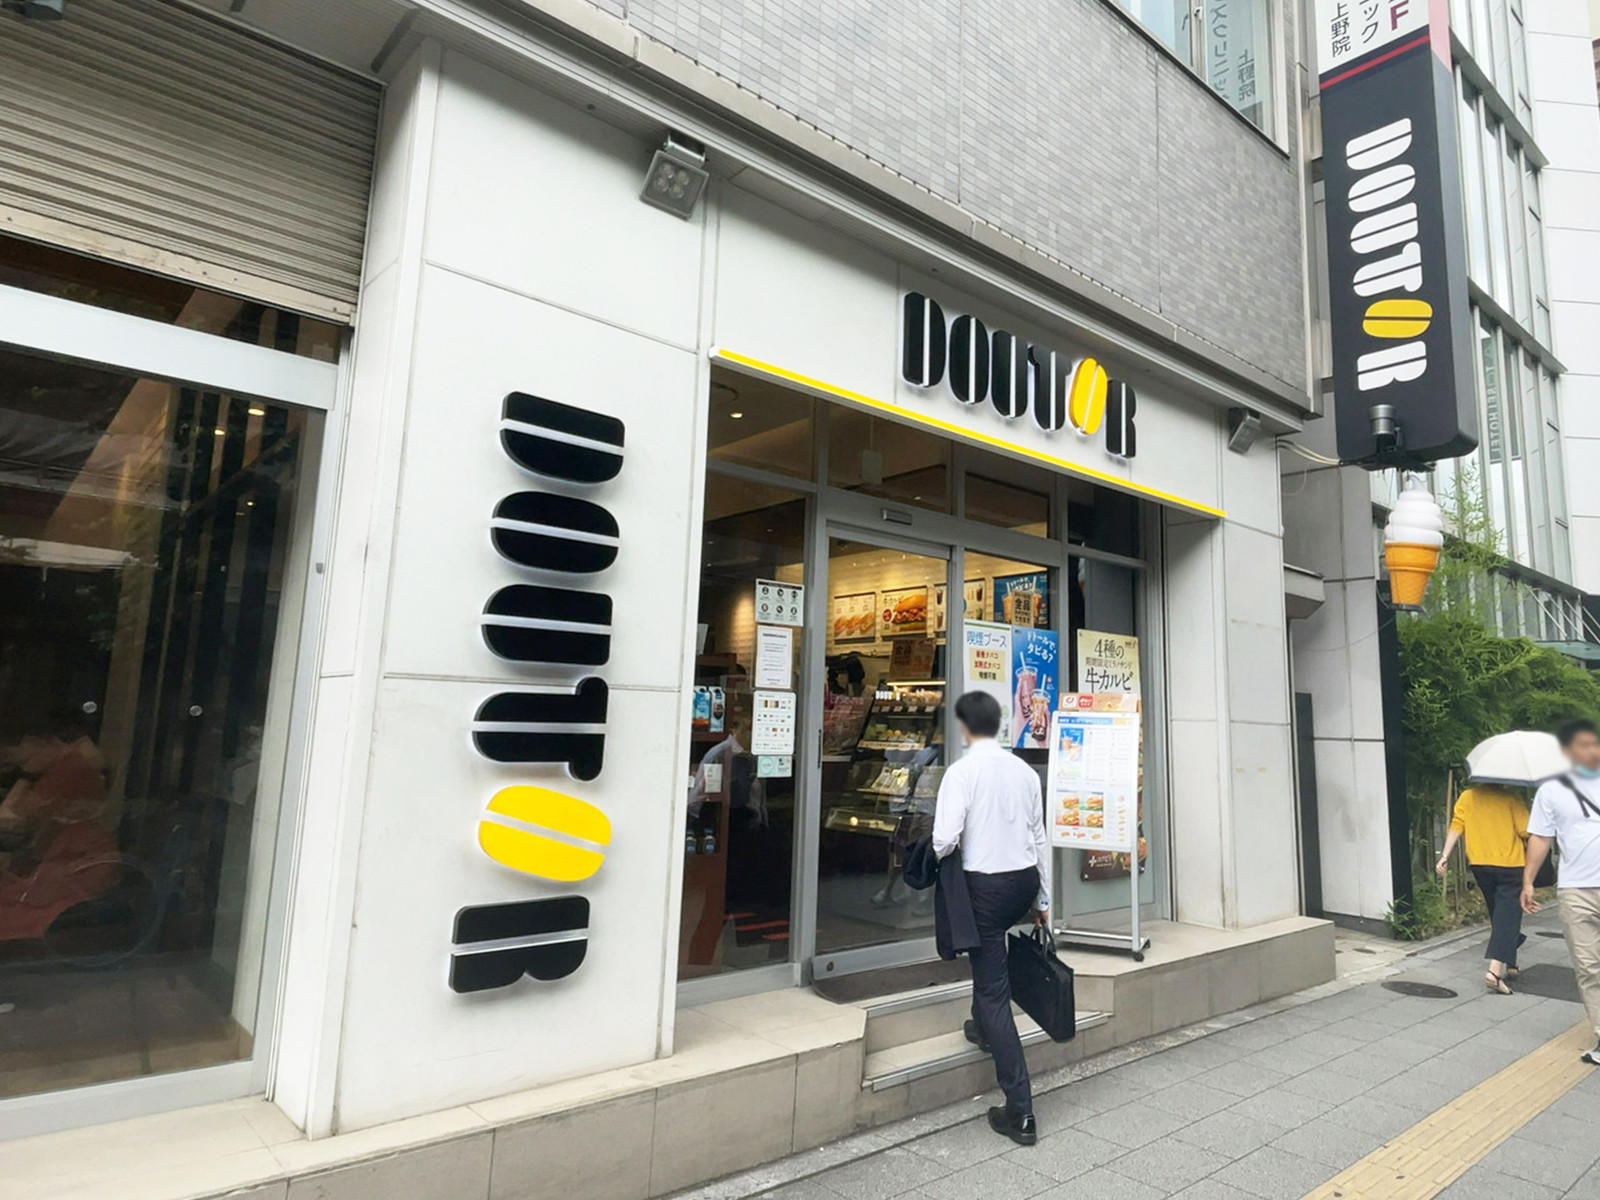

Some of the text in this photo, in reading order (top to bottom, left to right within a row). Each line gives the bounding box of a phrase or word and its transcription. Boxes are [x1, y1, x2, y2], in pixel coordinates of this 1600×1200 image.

[1330, 2, 1351, 58] 上野院
[1389, 0, 1409, 31] F
[1345, 117, 1434, 392] DOUTOR
[901, 292, 1137, 459] DOUTOR
[1094, 638, 1125, 659] 4種の
[447, 391, 626, 994] DOUTOR
[1085, 667, 1134, 693] 牛カルビ
